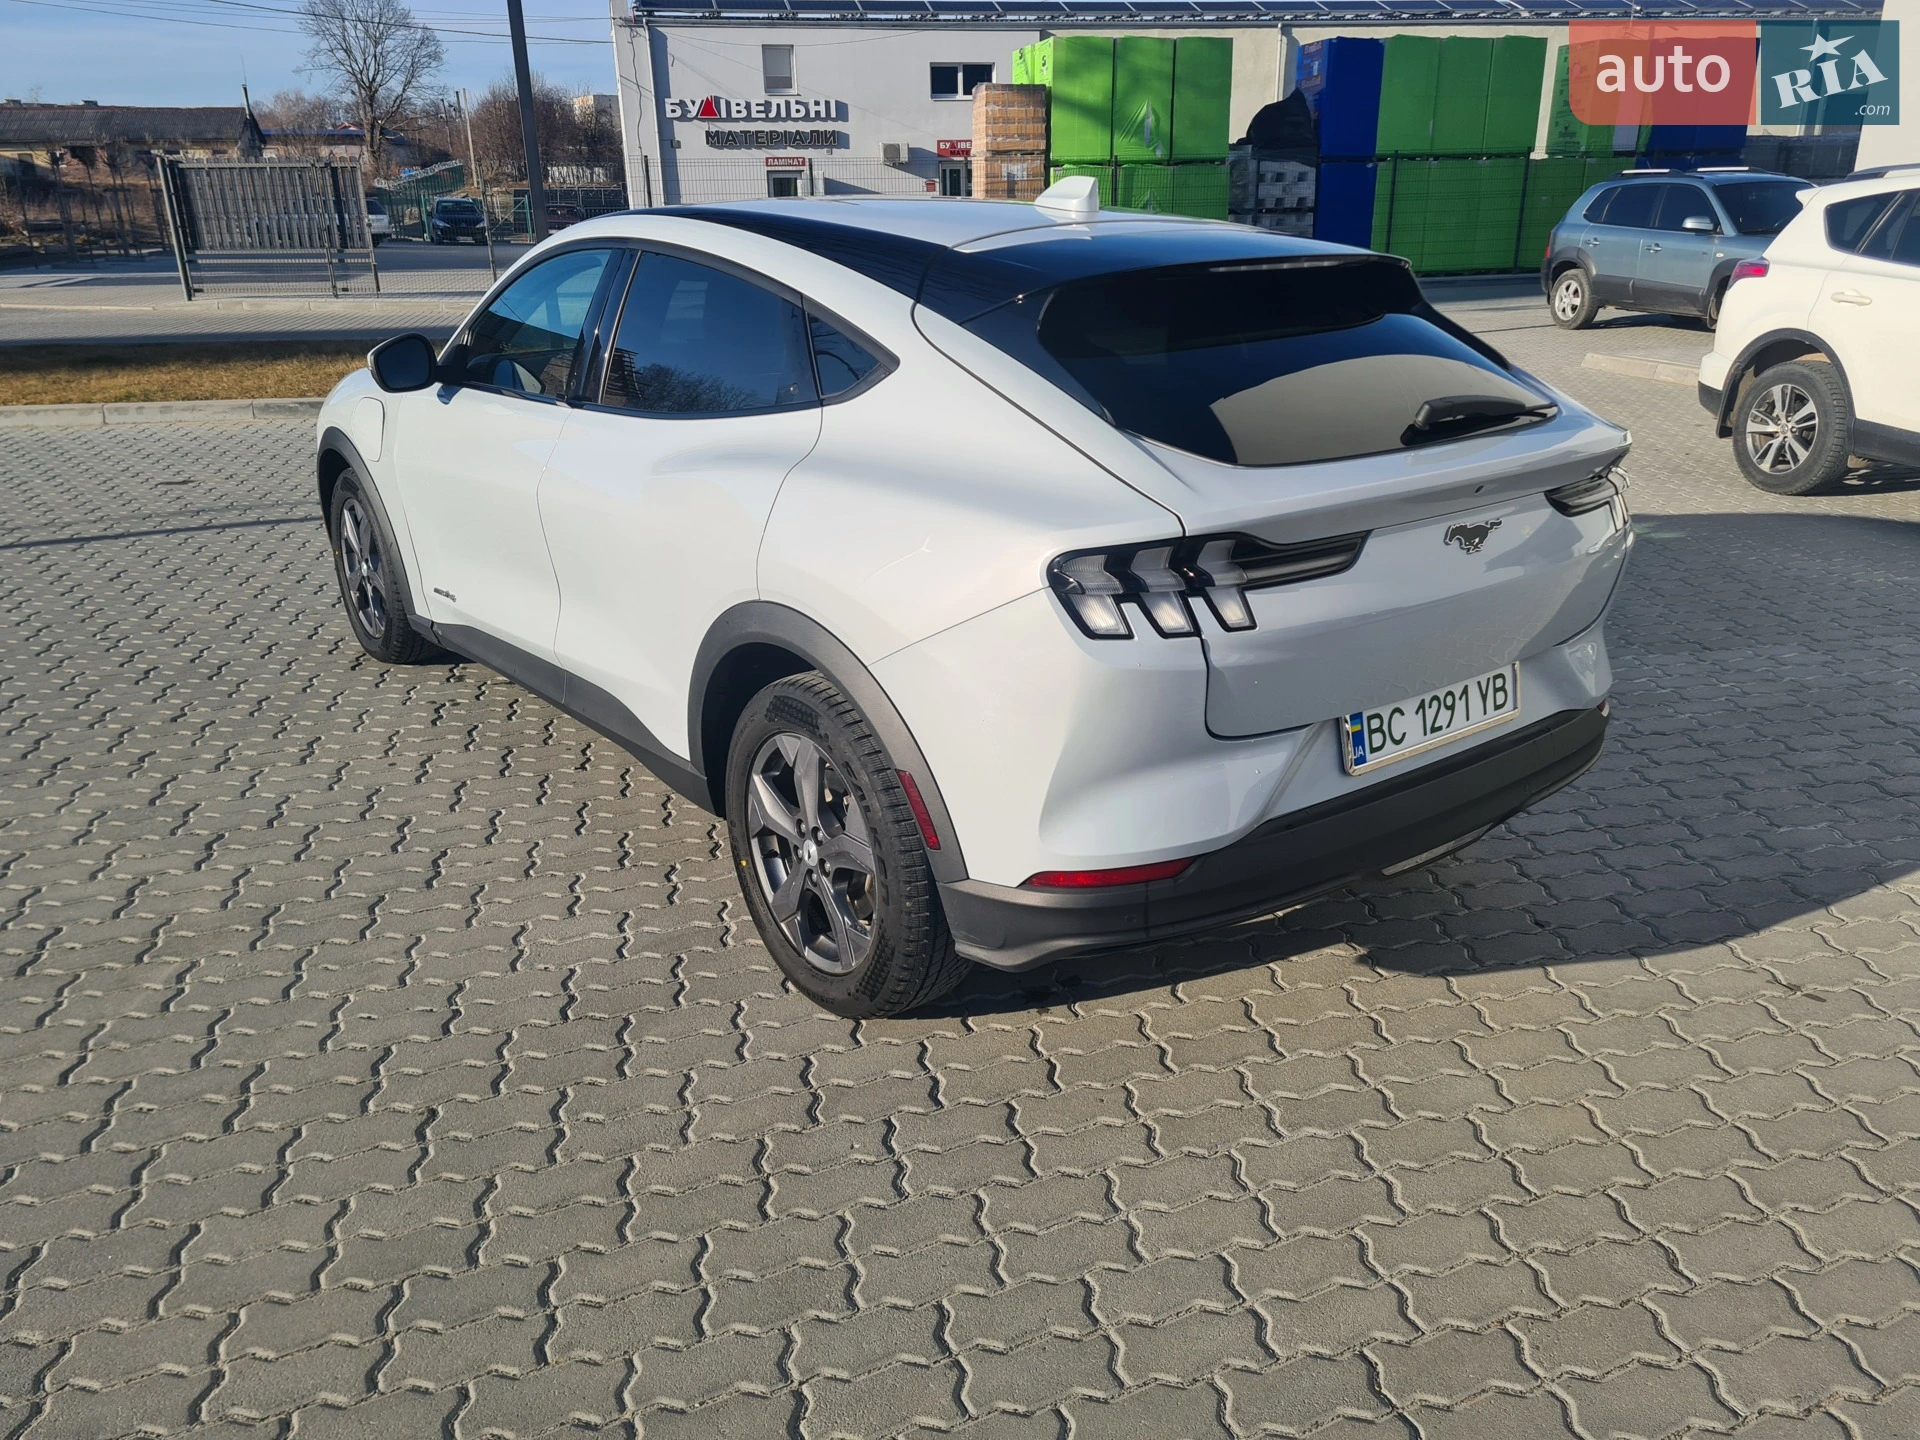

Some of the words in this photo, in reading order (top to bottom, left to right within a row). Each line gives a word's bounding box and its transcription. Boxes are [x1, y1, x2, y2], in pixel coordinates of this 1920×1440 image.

[665, 95, 837, 119] БУДІВЕЛЬНІ
[704, 129, 838, 147] МАТЕРІАЛИ
[767, 158, 804, 166] ЛАМІНАТ
[1366, 707, 1407, 754] BC
[1415, 684, 1470, 737] 1291
[1477, 673, 1508, 716] YB
